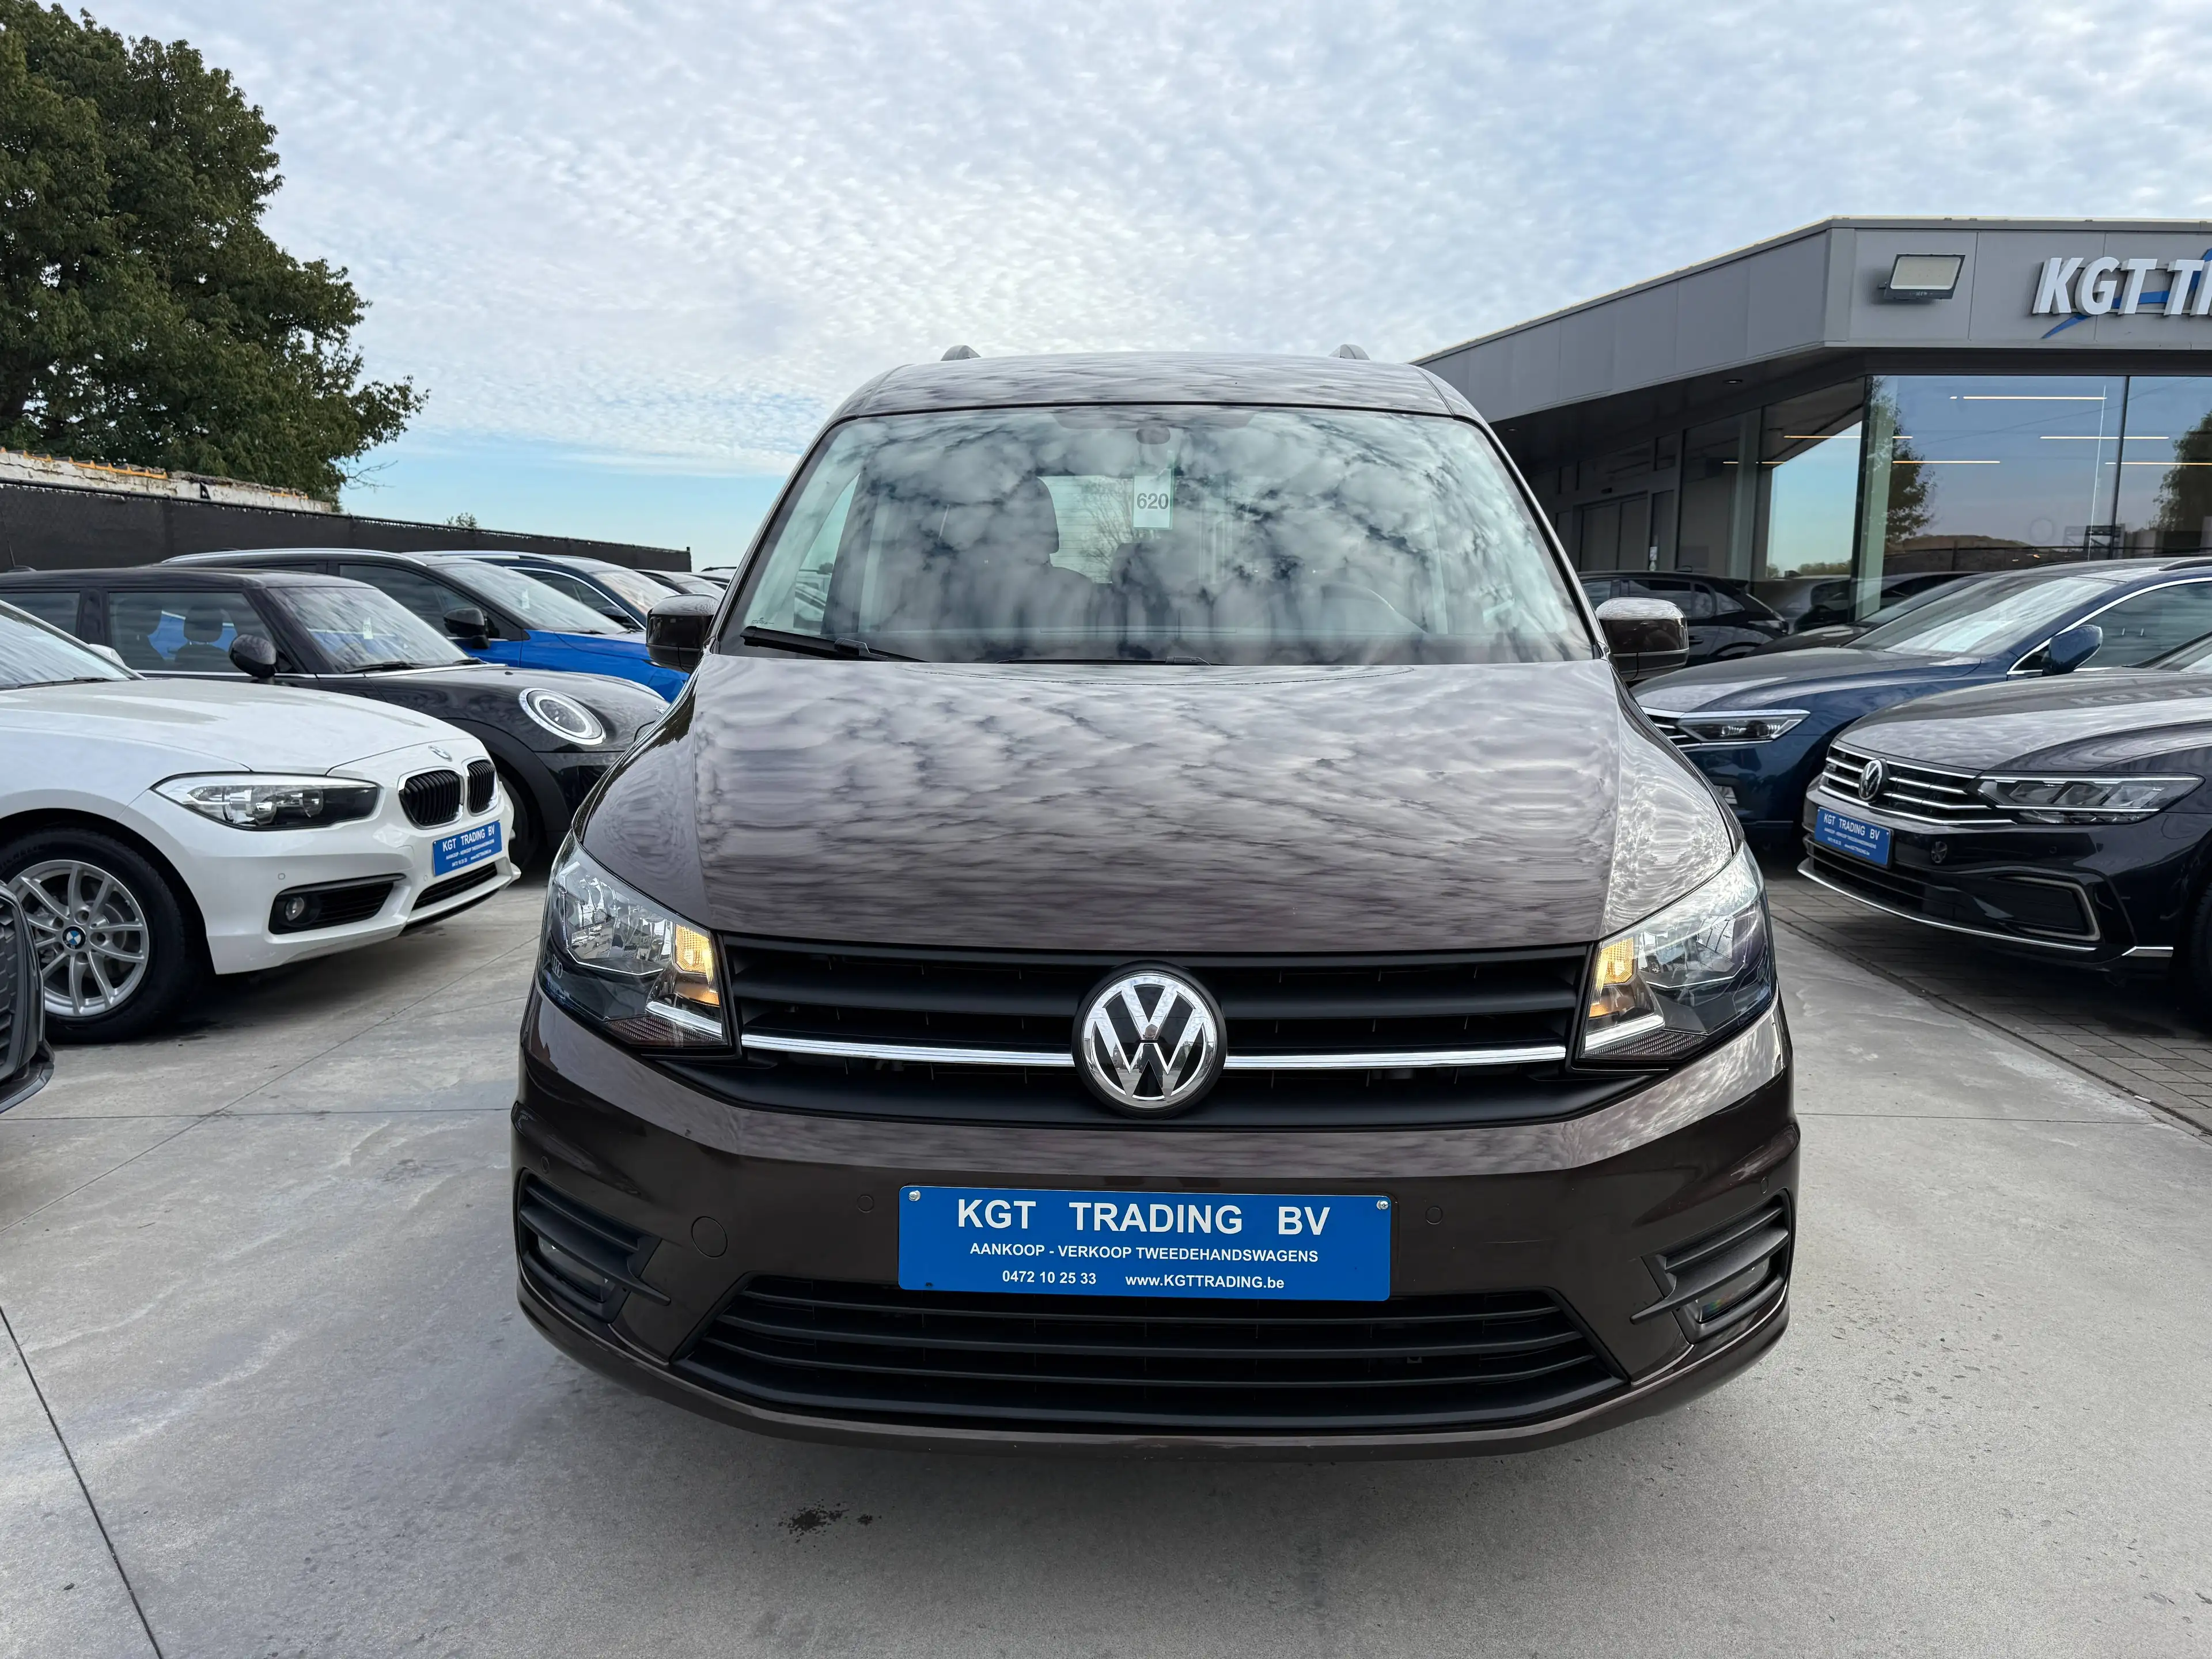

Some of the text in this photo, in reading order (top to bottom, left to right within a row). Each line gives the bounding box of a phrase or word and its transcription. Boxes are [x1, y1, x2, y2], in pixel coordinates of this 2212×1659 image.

[2032, 257, 2157, 315] KGT
[1137, 493, 1169, 510] 620
[442, 838, 456, 852] KGT
[460, 829, 485, 846] TRADING
[488, 825, 495, 836] BV
[1824, 813, 1836, 825] KGT
[1839, 818, 1865, 836] TRADING
[1870, 828, 1880, 840] BV
[958, 1199, 1331, 1235] KGT TRADING BV
[970, 1243, 1045, 1256] AANKOOP
[1058, 1245, 1132, 1259] VERKOOP
[1135, 1247, 1319, 1263] TWEEDEHANDSWAGENS
[1002, 1270, 1285, 1289] 0472 10 25 33 www.KGTTRADING.be
